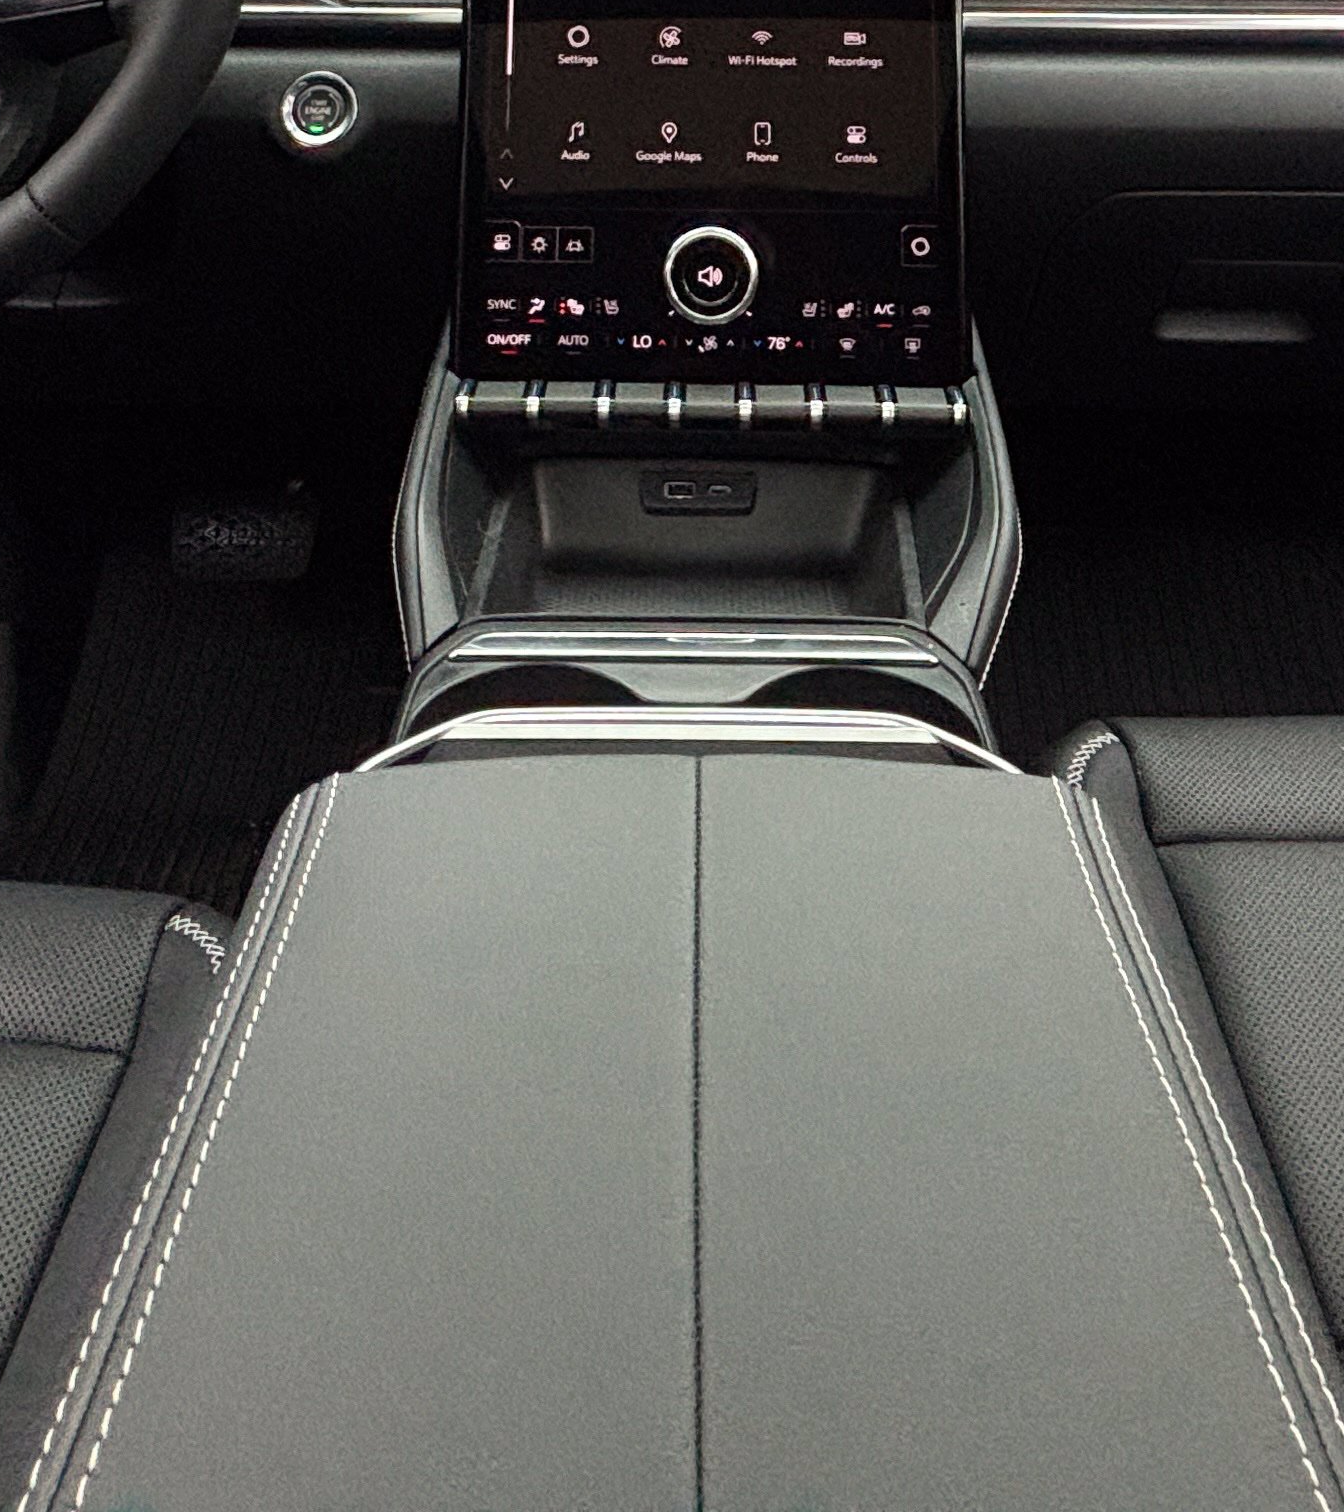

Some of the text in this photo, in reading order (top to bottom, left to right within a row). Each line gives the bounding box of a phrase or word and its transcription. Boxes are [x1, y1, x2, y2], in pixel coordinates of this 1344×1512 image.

[558, 54, 598, 67] Settings
[651, 55, 689, 65] Climate
[757, 56, 797, 68] Hotspot
[828, 56, 883, 69] Recordings
[561, 150, 590, 160] Audio
[636, 151, 702, 163] Google Maps
[747, 152, 778, 162] Phone
[835, 153, 878, 163] Controls
[487, 299, 517, 310] SYNC
[874, 303, 895, 314] A/C
[487, 334, 532, 346] ON/OFF
[558, 335, 589, 346] AUTO
[632, 335, 653, 349] LO
[768, 336, 791, 350] 76°
